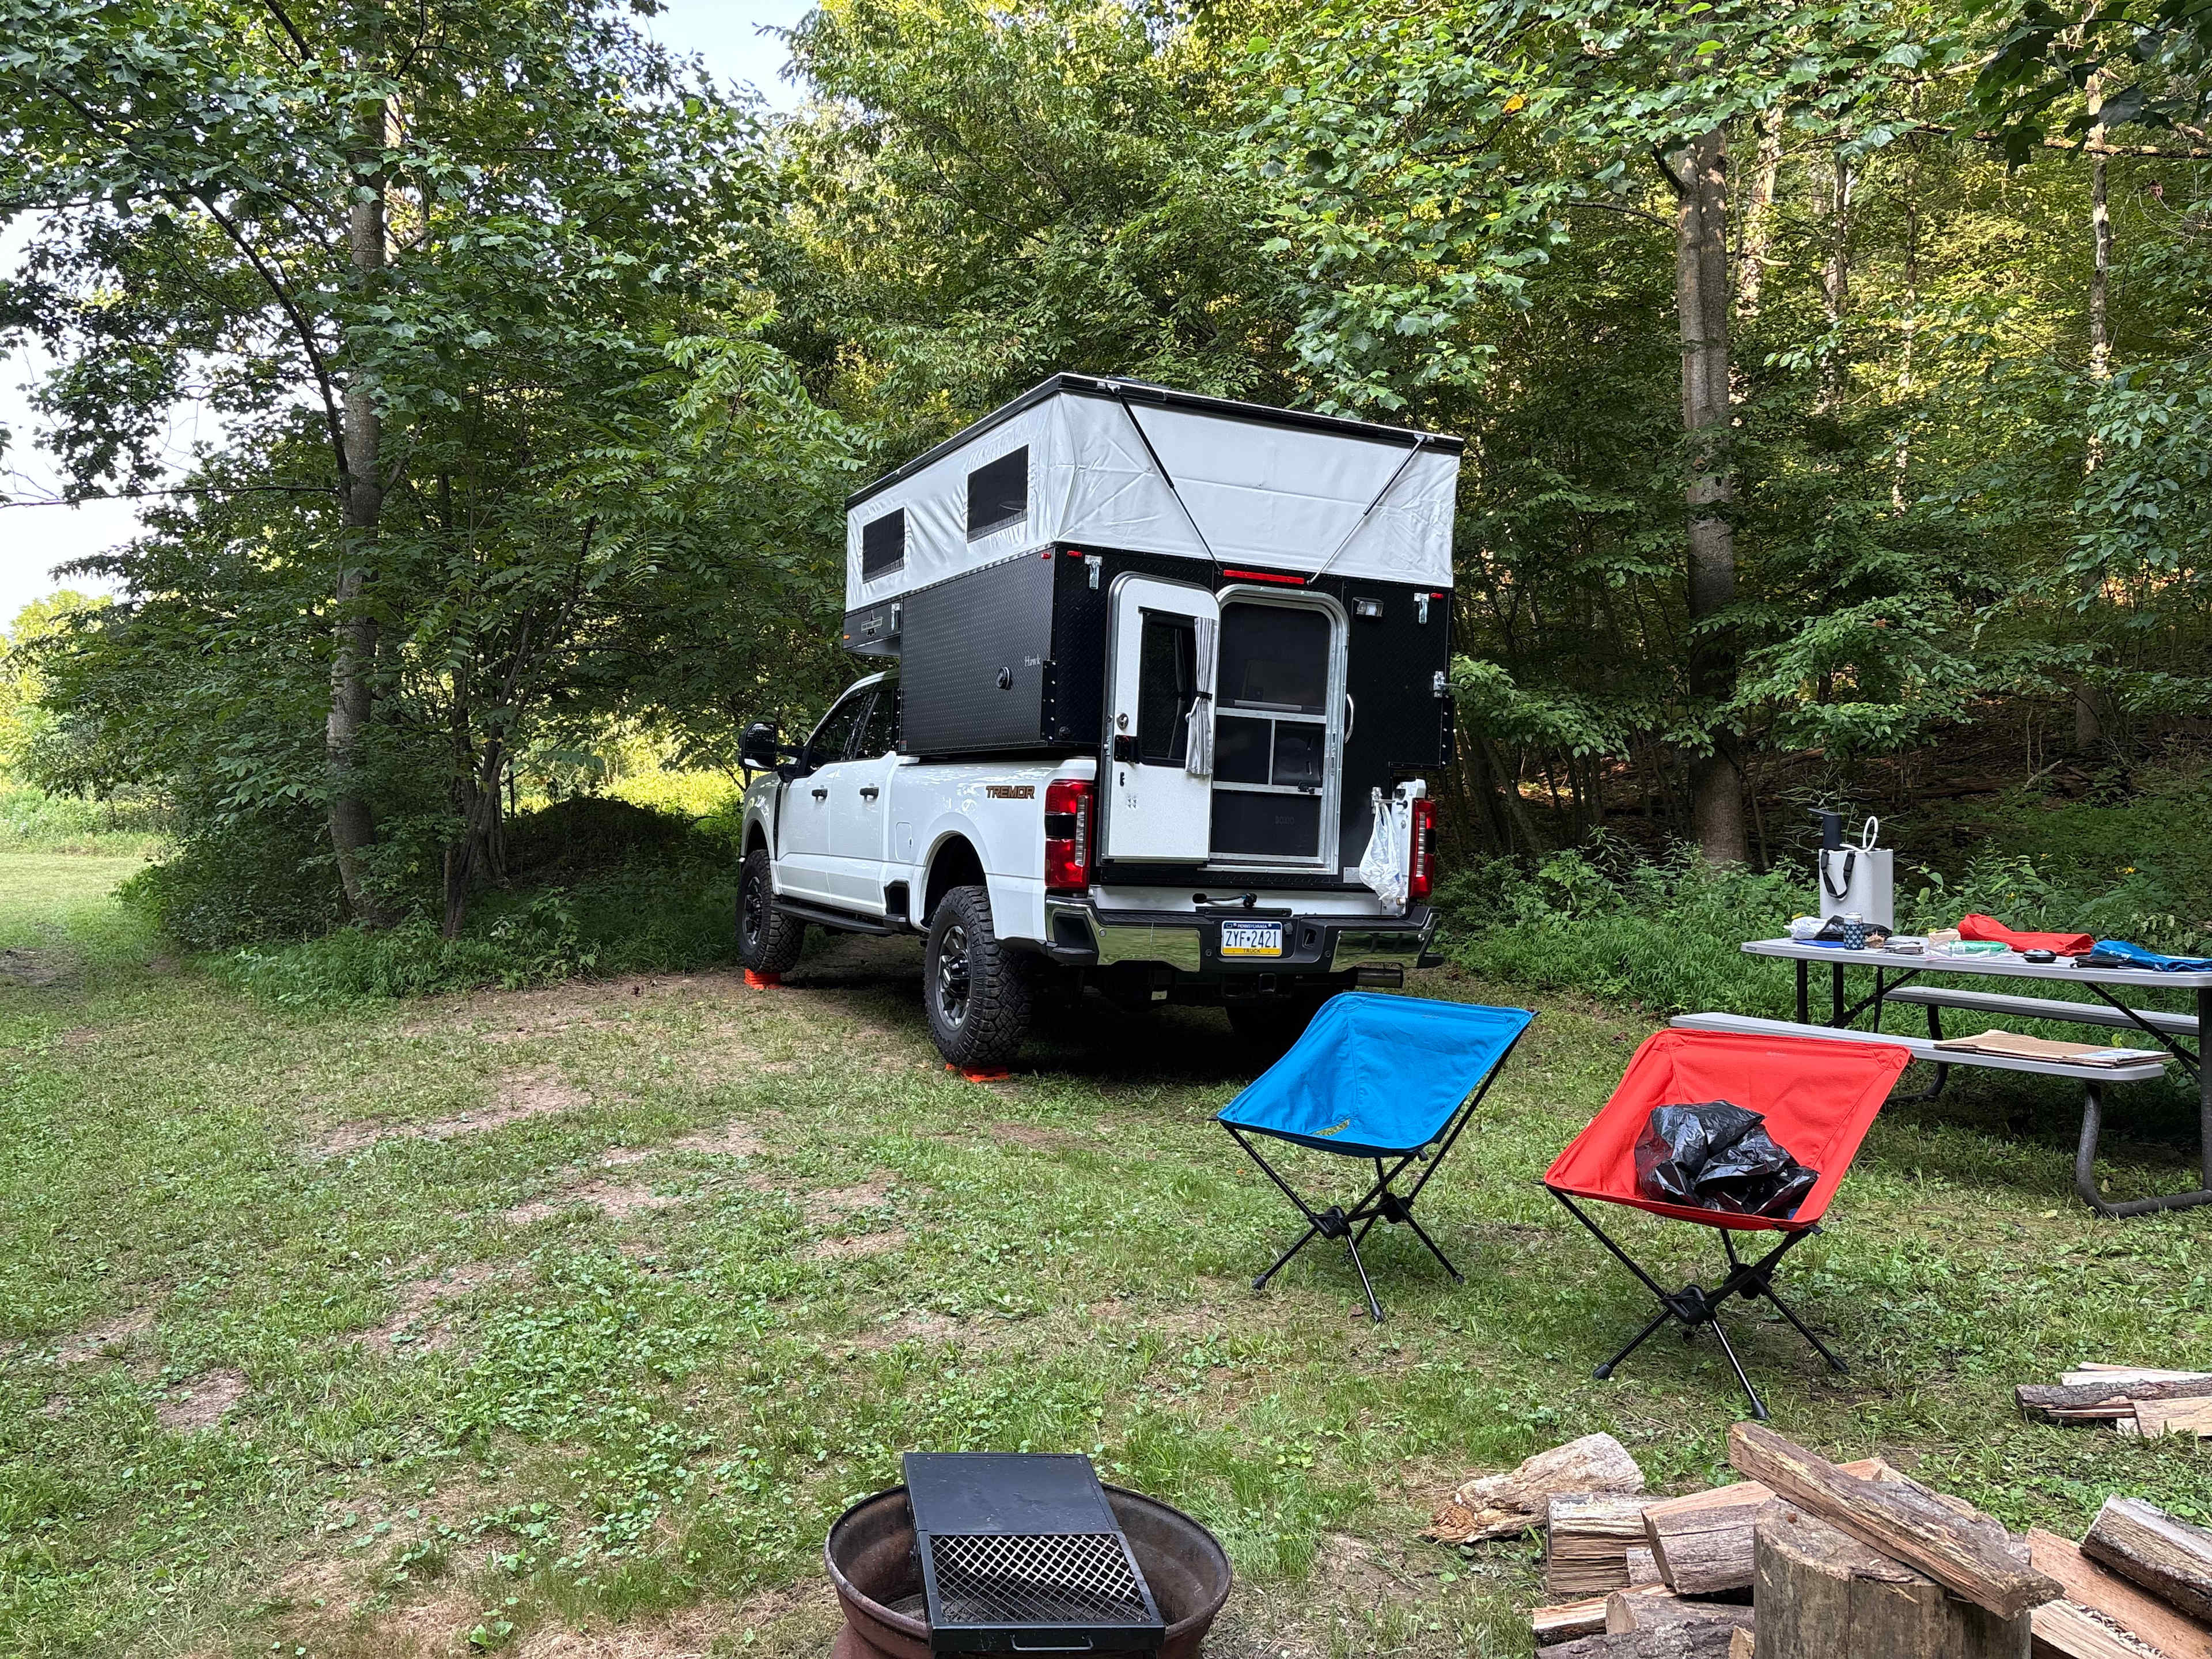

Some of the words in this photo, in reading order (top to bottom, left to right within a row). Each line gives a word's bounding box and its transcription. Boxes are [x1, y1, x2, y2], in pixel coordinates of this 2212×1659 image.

[1024, 654, 1041, 667] Hawk
[986, 785, 1035, 799] TREMOR
[1226, 931, 1247, 946] ZYF
[1251, 931, 1277, 948] 2421
